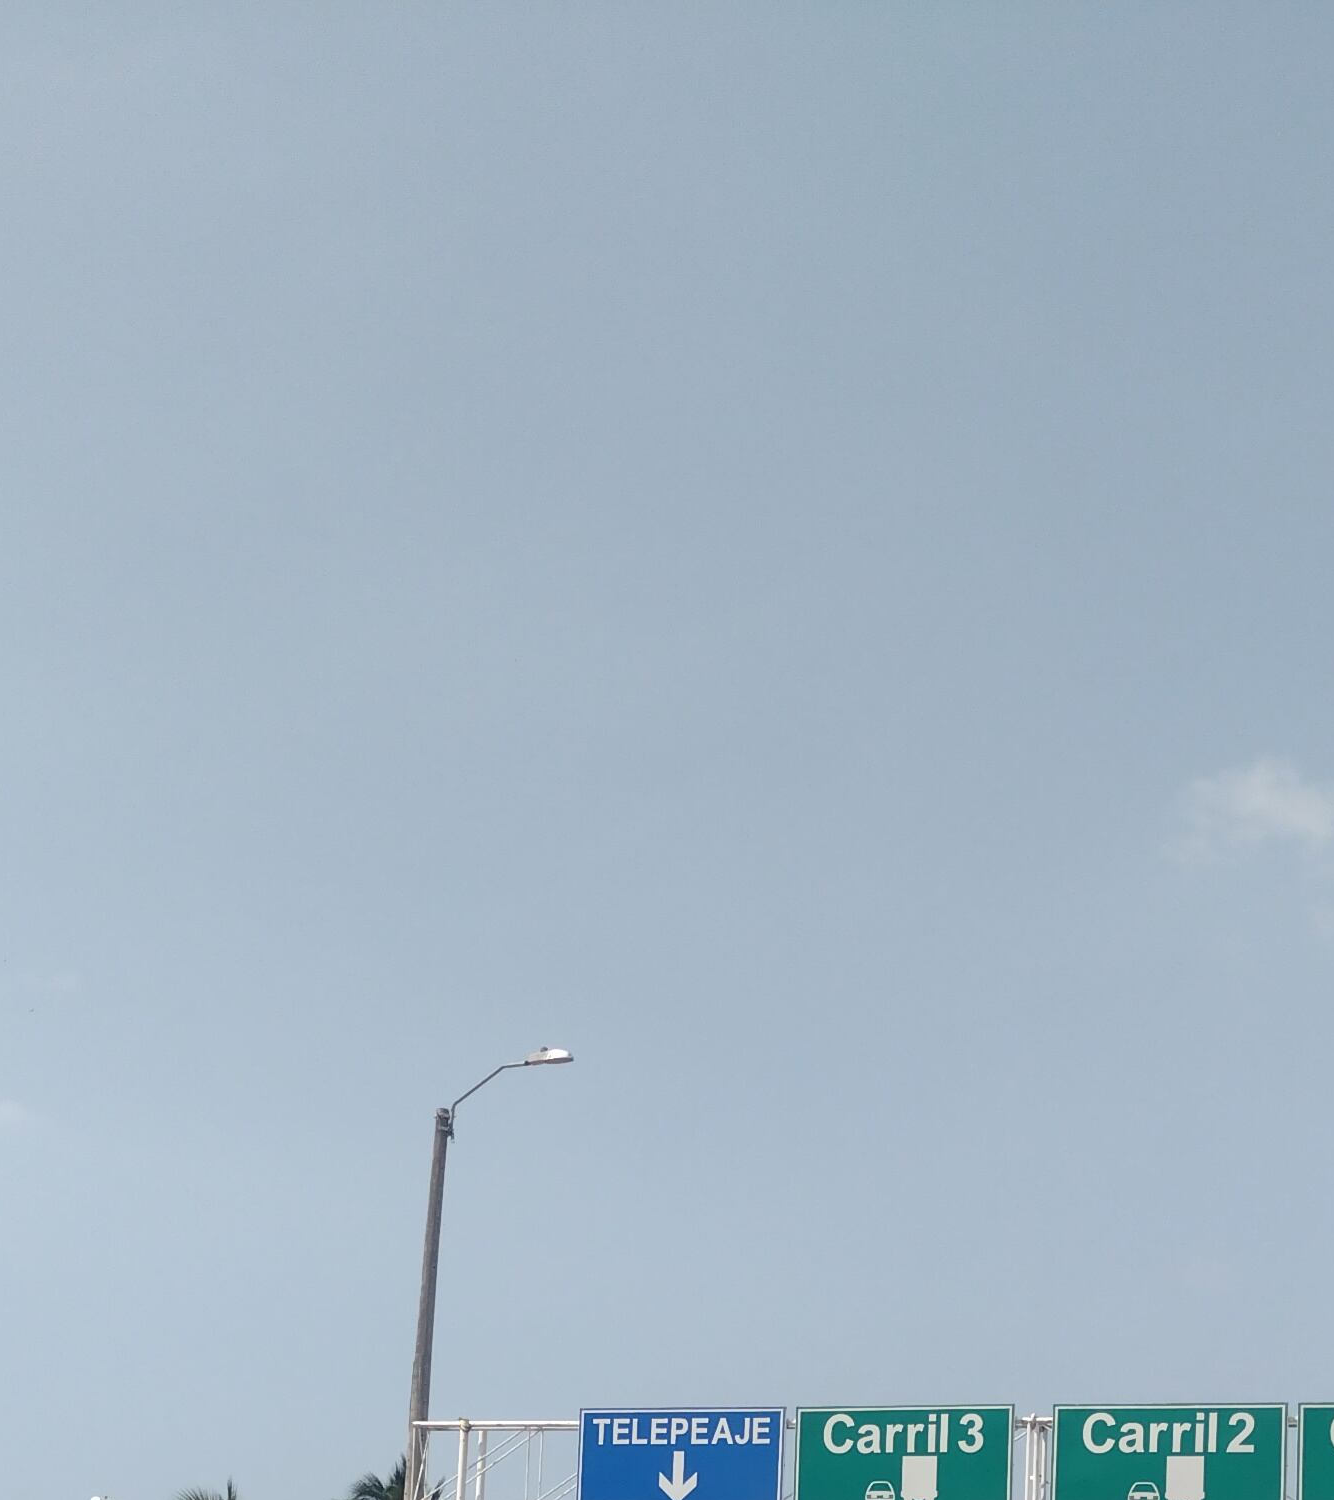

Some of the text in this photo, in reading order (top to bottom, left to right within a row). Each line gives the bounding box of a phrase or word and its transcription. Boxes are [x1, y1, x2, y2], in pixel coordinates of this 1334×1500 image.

[592, 1417, 771, 1445] TELEPEAJE
[822, 1413, 985, 1454] Carril 3
[1082, 1412, 1256, 1454] Carril 2
